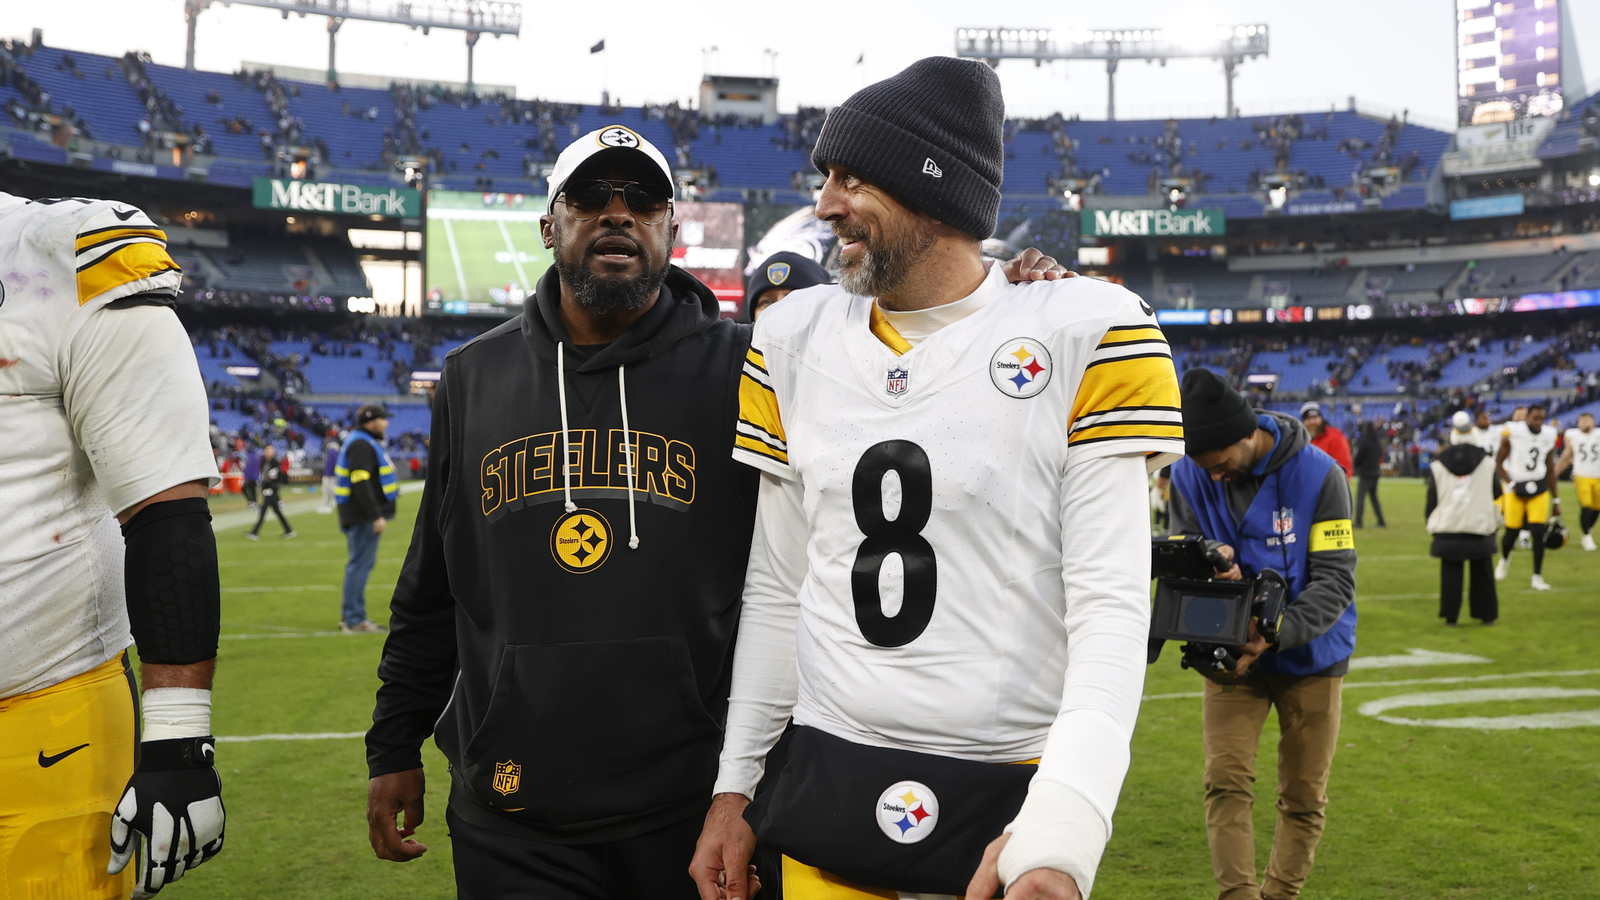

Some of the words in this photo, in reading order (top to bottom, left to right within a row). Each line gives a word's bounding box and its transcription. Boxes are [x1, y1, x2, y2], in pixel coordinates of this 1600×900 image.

[270, 179, 342, 212] M&T
[341, 184, 406, 215] Bank
[1094, 209, 1155, 235] M&T
[1154, 209, 1213, 235] Bank
[996, 361, 1020, 370] Steelers
[889, 379, 905, 392] NFL
[1526, 447, 1540, 471] 3
[480, 428, 696, 516] STEELERS
[1276, 519, 1291, 531] NFL
[1324, 529, 1344, 537] WEEK
[559, 537, 580, 545] Steelers
[851, 438, 937, 648] 8
[1266, 537, 1281, 546] NFL
[496, 774, 516, 791] NFL
[883, 802, 906, 814] Steelers
